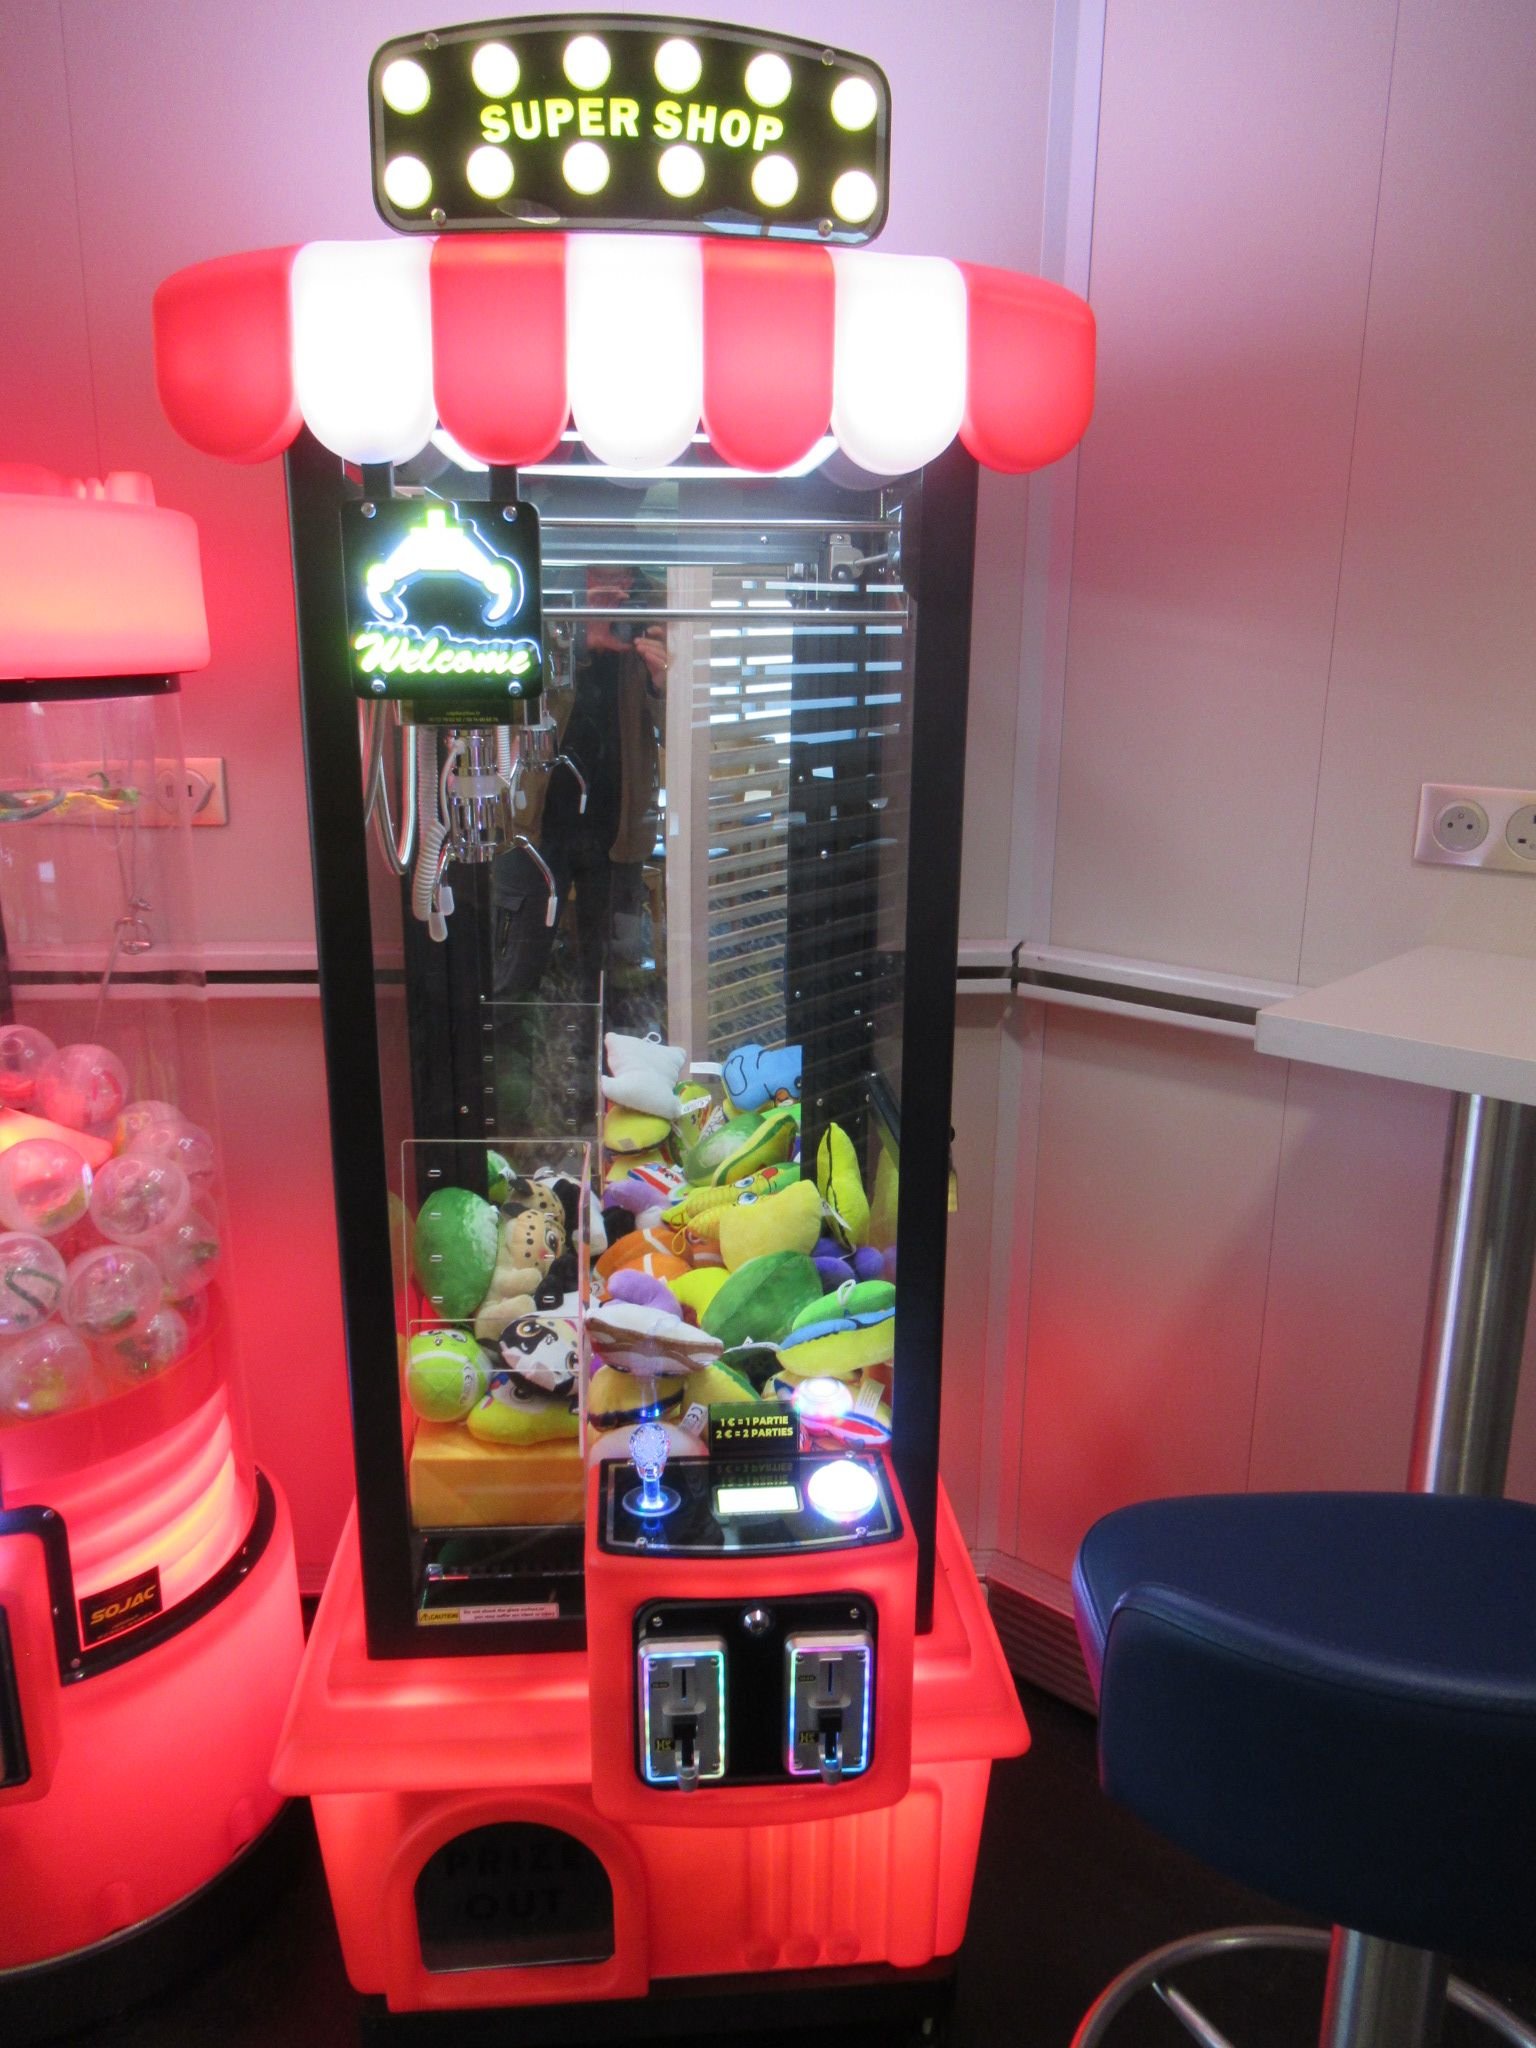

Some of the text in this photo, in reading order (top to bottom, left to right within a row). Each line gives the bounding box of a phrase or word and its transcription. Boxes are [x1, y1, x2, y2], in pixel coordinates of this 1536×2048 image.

[479, 97, 784, 151] SUPER SHOP
[354, 632, 531, 675] Welcome
[716, 1429, 722, 1439] 2
[724, 1429, 733, 1439] €
[751, 1427, 794, 1438] PARTIES
[720, 1417, 725, 1427] 1
[727, 1417, 736, 1427] €
[745, 1416, 750, 1426] 1
[752, 1415, 789, 1426] PARTIE
[90, 1584, 157, 1625] SOJAC
[465, 1889, 566, 1920] OUT
